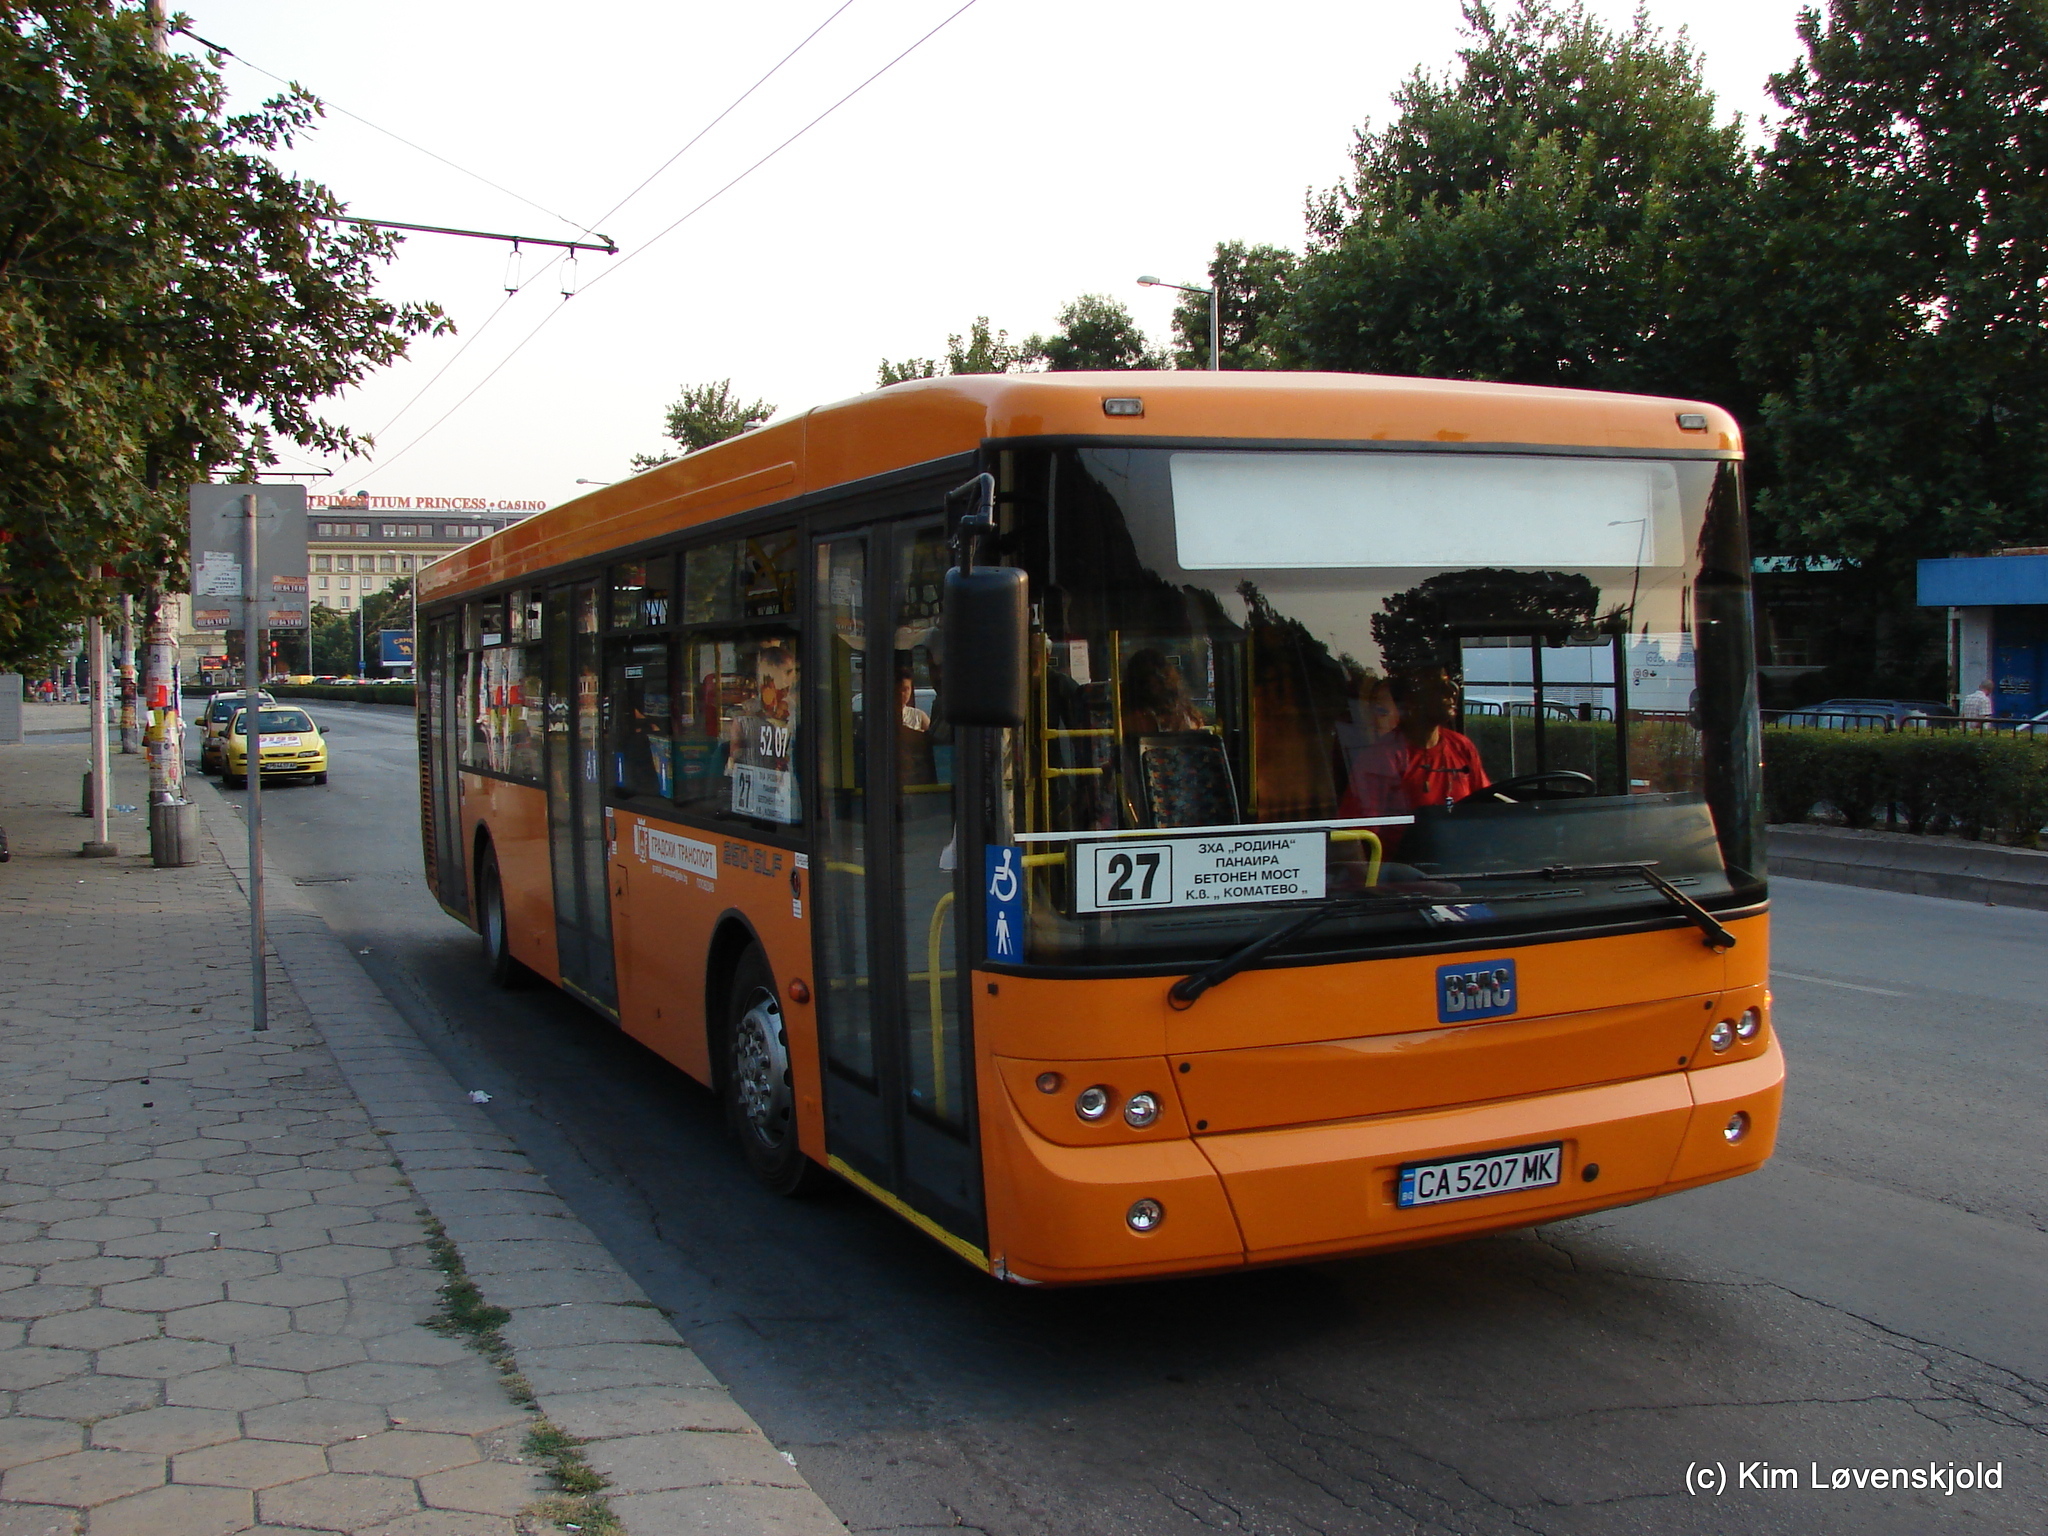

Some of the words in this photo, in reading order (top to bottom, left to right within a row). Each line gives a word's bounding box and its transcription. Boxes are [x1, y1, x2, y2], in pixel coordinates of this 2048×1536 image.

[416, 497, 486, 509] PRINCESS
[498, 500, 547, 510] CASINO
[760, 725, 773, 757] 52
[775, 727, 788, 758] 07
[739, 772, 751, 809] 27
[1198, 843, 1224, 854] ЗХА
[1216, 855, 1279, 868] ПАНАИРА
[1107, 853, 1160, 902] 27
[1194, 871, 1257, 884] БЕТОНЕН
[1261, 868, 1300, 881] МОСТ
[1223, 883, 1298, 898] КОМАТЕВО
[1445, 967, 1511, 1013] BMC
